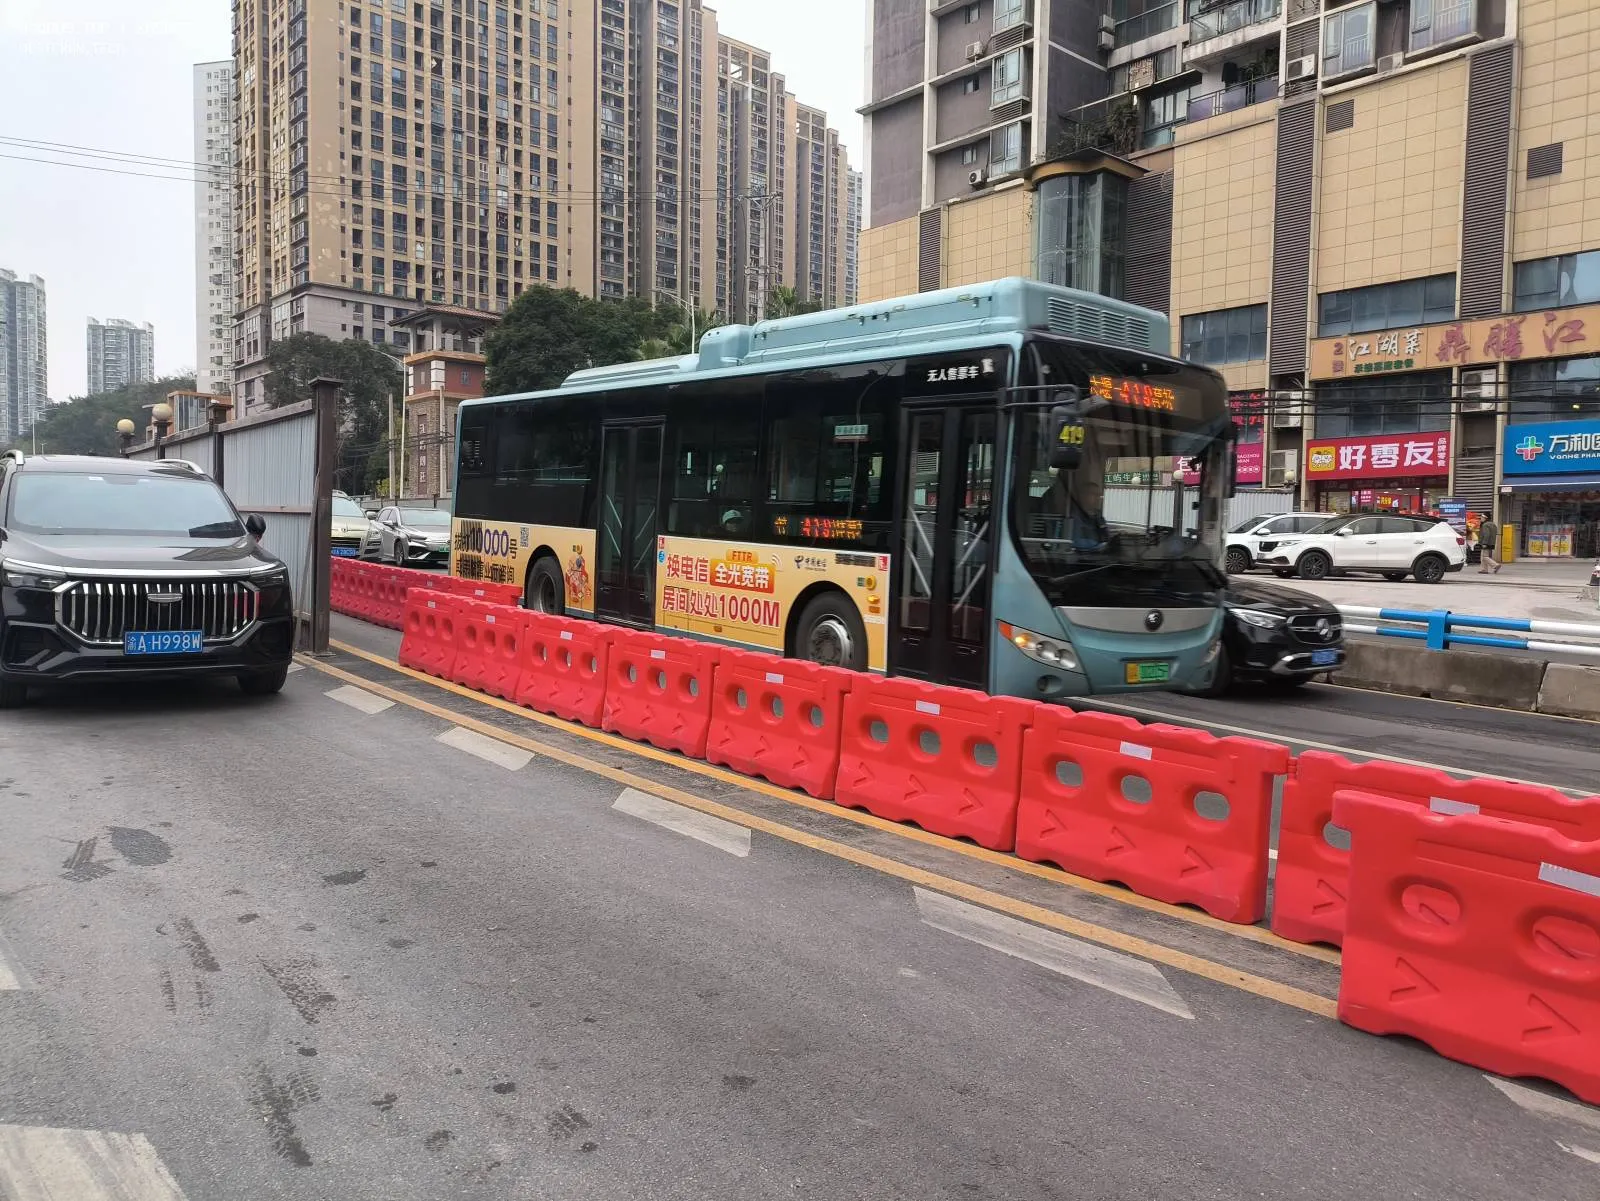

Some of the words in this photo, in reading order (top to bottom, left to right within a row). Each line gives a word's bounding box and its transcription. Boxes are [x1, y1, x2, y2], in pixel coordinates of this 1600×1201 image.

[667, 553, 709, 583] 换电信
[732, 550, 753, 563] FTTR
[715, 562, 769, 589] 全光宽带
[663, 585, 780, 628] 房间处处1000M
